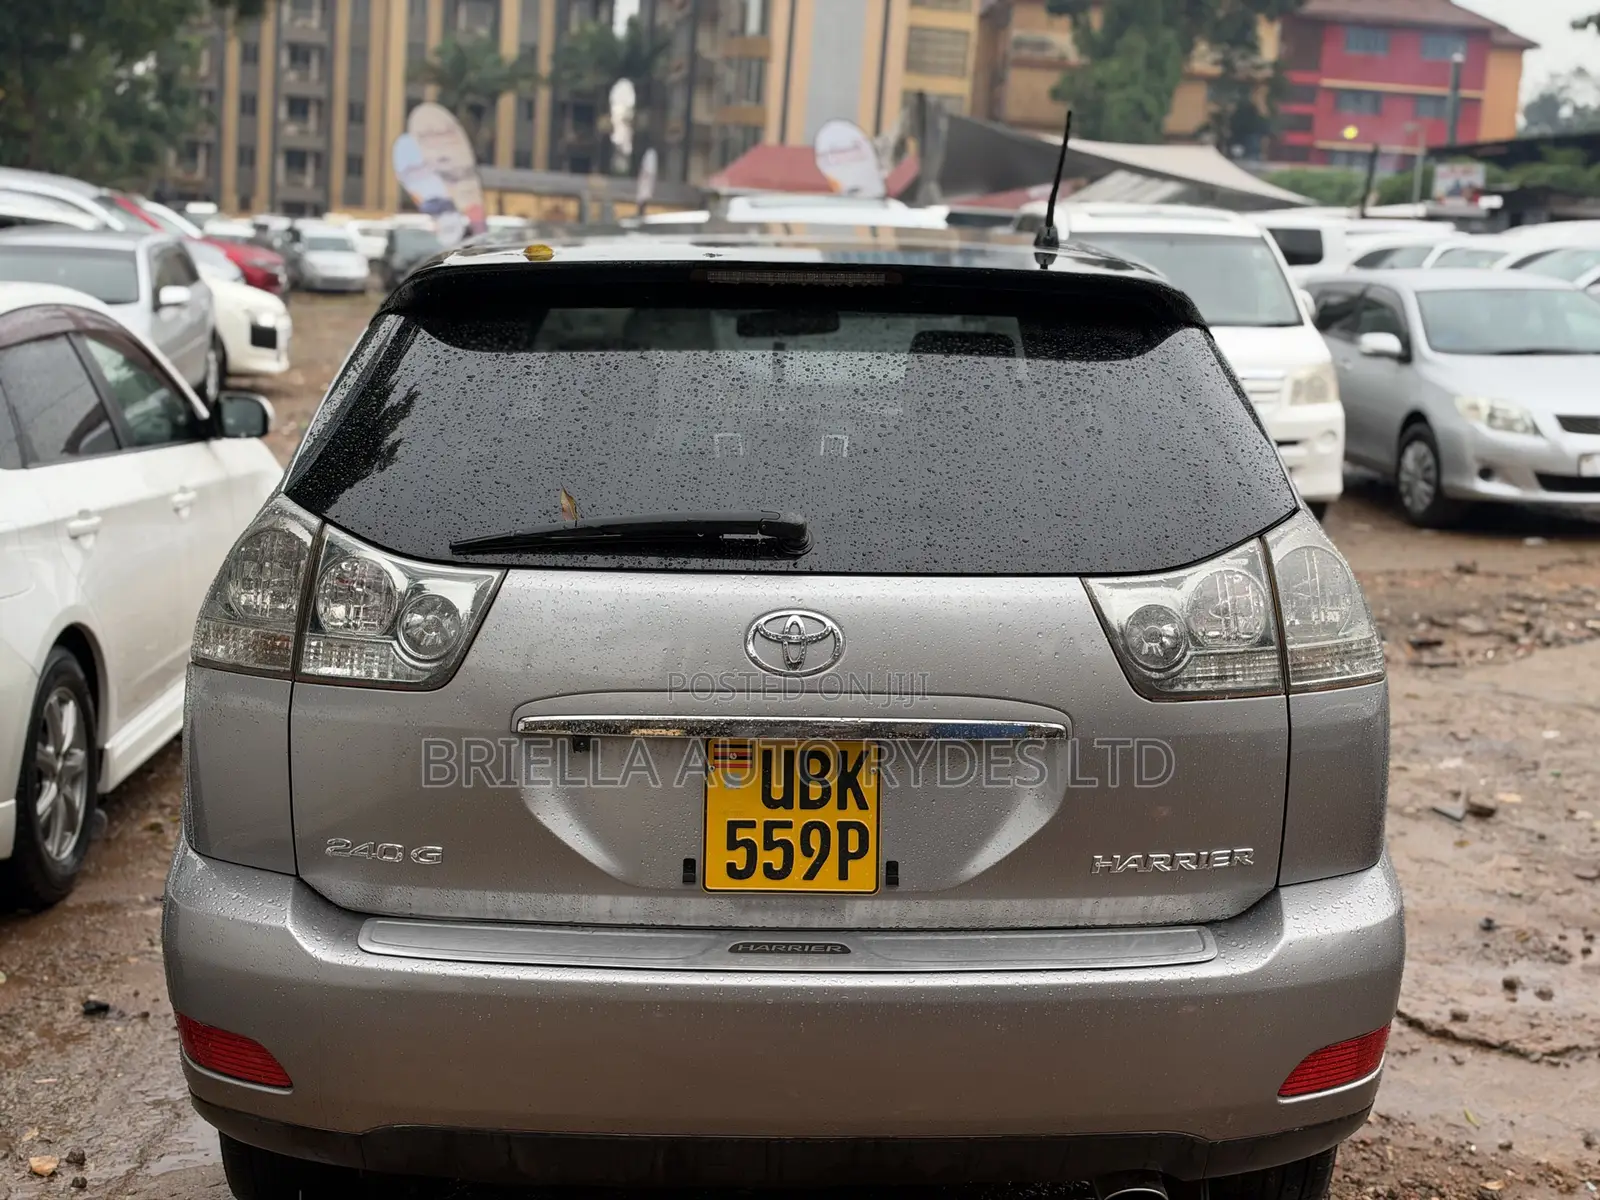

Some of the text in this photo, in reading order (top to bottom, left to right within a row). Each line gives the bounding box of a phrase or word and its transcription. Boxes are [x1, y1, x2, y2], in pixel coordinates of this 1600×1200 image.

[761, 750, 870, 811] UBK
[726, 820, 870, 881] 559P
[1091, 848, 1254, 874] HARRIER
[737, 943, 843, 953] HARRIER
